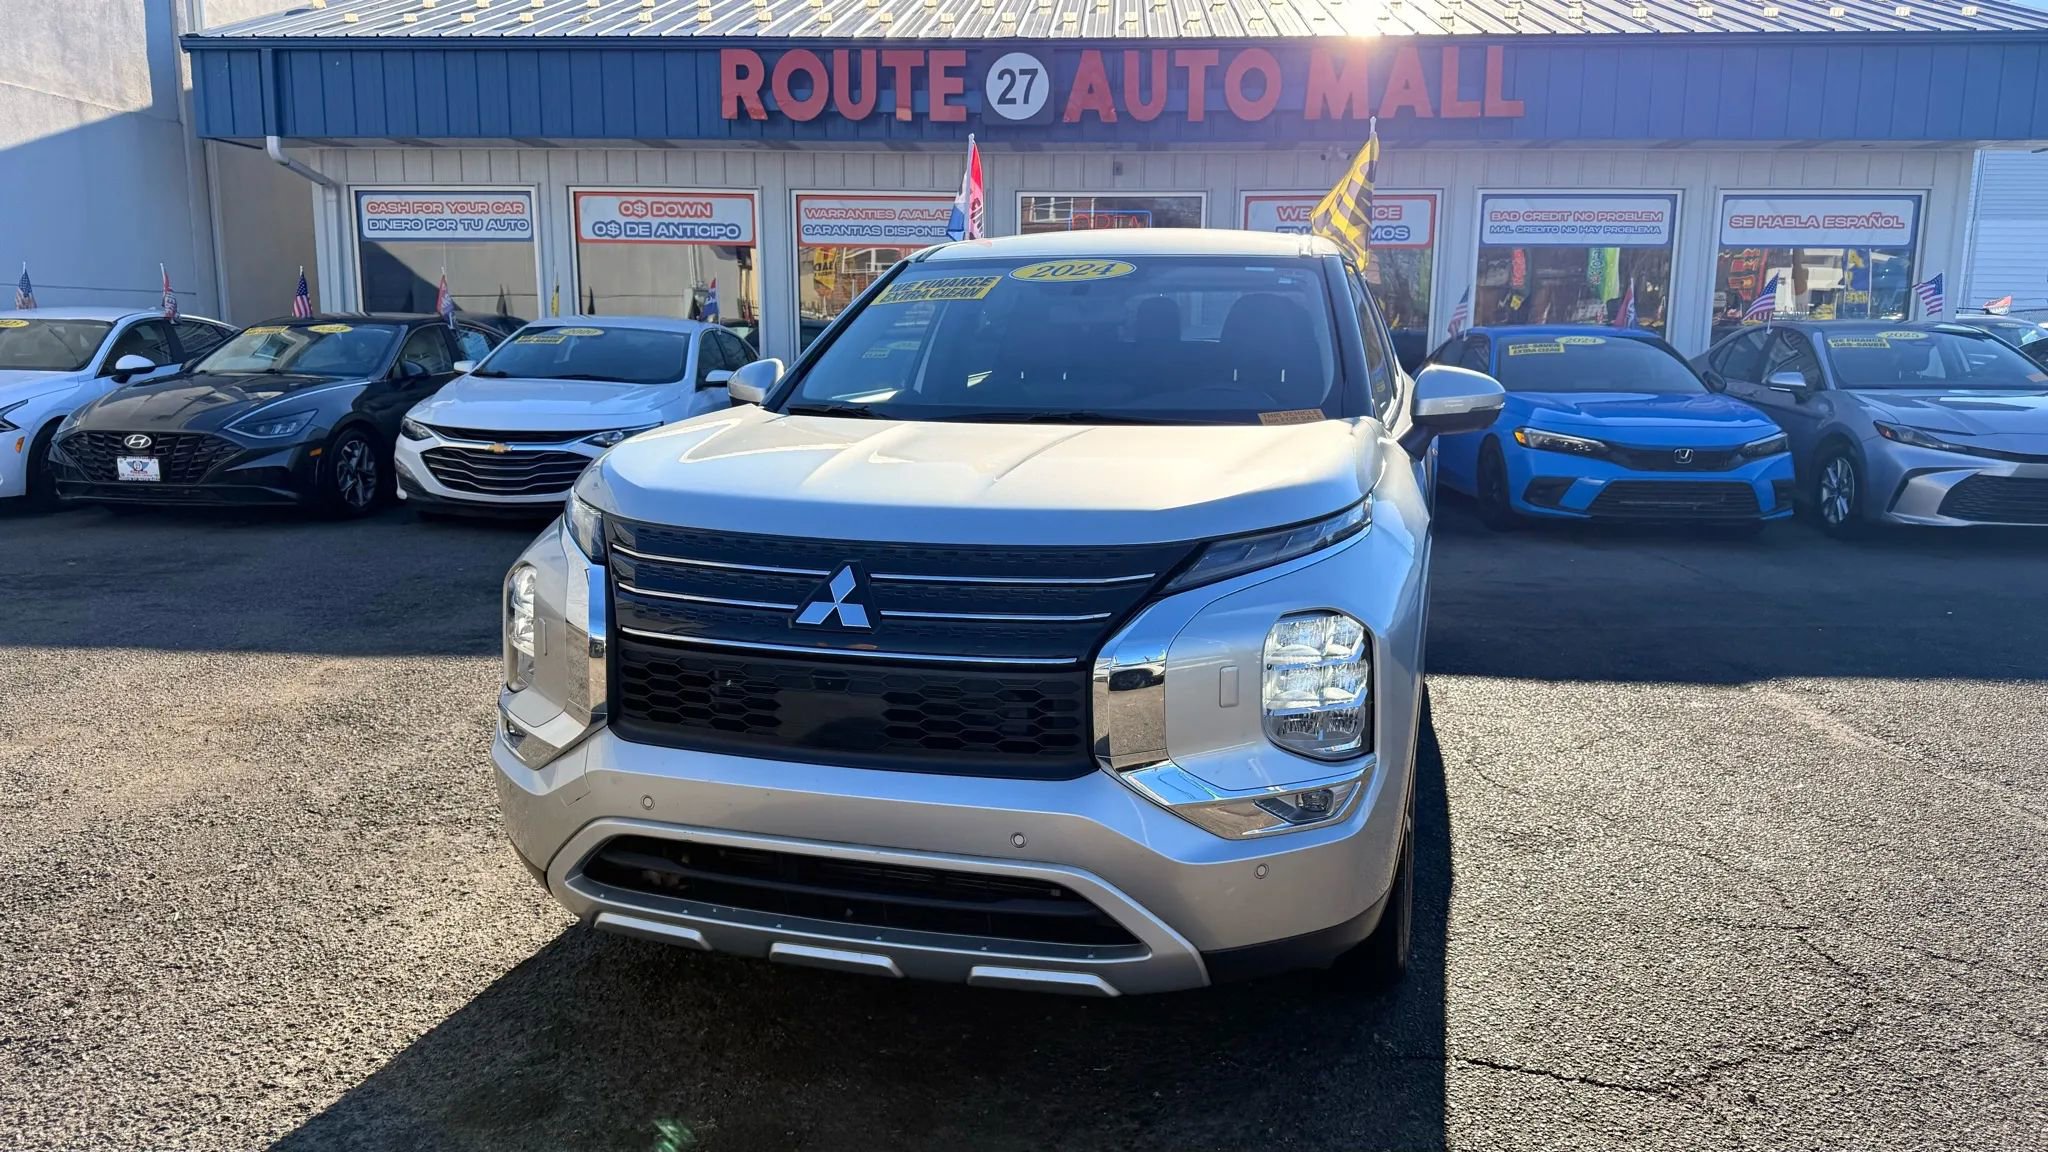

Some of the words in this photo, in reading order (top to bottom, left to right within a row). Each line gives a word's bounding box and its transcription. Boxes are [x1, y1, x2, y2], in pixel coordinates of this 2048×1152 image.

[720, 48, 966, 122] ROUTE
[997, 68, 1038, 105] 27
[1062, 48, 1281, 122] AUTO
[1304, 46, 1524, 120] MALL
[367, 202, 410, 214] CASH
[413, 202, 443, 214] FOR
[447, 202, 489, 214] YOUR
[492, 202, 524, 214] CAR
[650, 201, 713, 218] DOWN
[804, 208, 895, 220] WARRANTIES
[898, 209, 951, 221] AVAILAB
[1277, 206, 1312, 221] WE
[1490, 211, 1520, 222] BAD
[1522, 211, 1571, 222] CREDIT
[1573, 211, 1593, 222] NO
[1597, 211, 1663, 222] PROBLEM
[1729, 215, 1755, 229] SE
[1757, 215, 1820, 229] HABLA
[1823, 212, 1904, 229] ESPAÑOL
[368, 218, 423, 231] DINERO
[426, 218, 457, 231] POR
[460, 218, 483, 231] TU
[486, 218, 529, 231] AUTO
[624, 221, 652, 237] DE
[652, 222, 741, 239] ANTICIPO
[802, 224, 881, 236] GARANTIAS
[884, 226, 947, 237] DISPONIB
[1490, 225, 1514, 233] MAL
[1516, 225, 1558, 233] CREDITO
[1561, 225, 1576, 233] NO
[1579, 225, 1602, 233] HAY
[1603, 225, 1661, 234] PROBLEMA
[1032, 263, 1117, 278] 2024
[893, 281, 918, 291] WE
[919, 276, 998, 289] FINANCE
[883, 288, 929, 302] EXTRA
[930, 287, 983, 298] CLEAN
